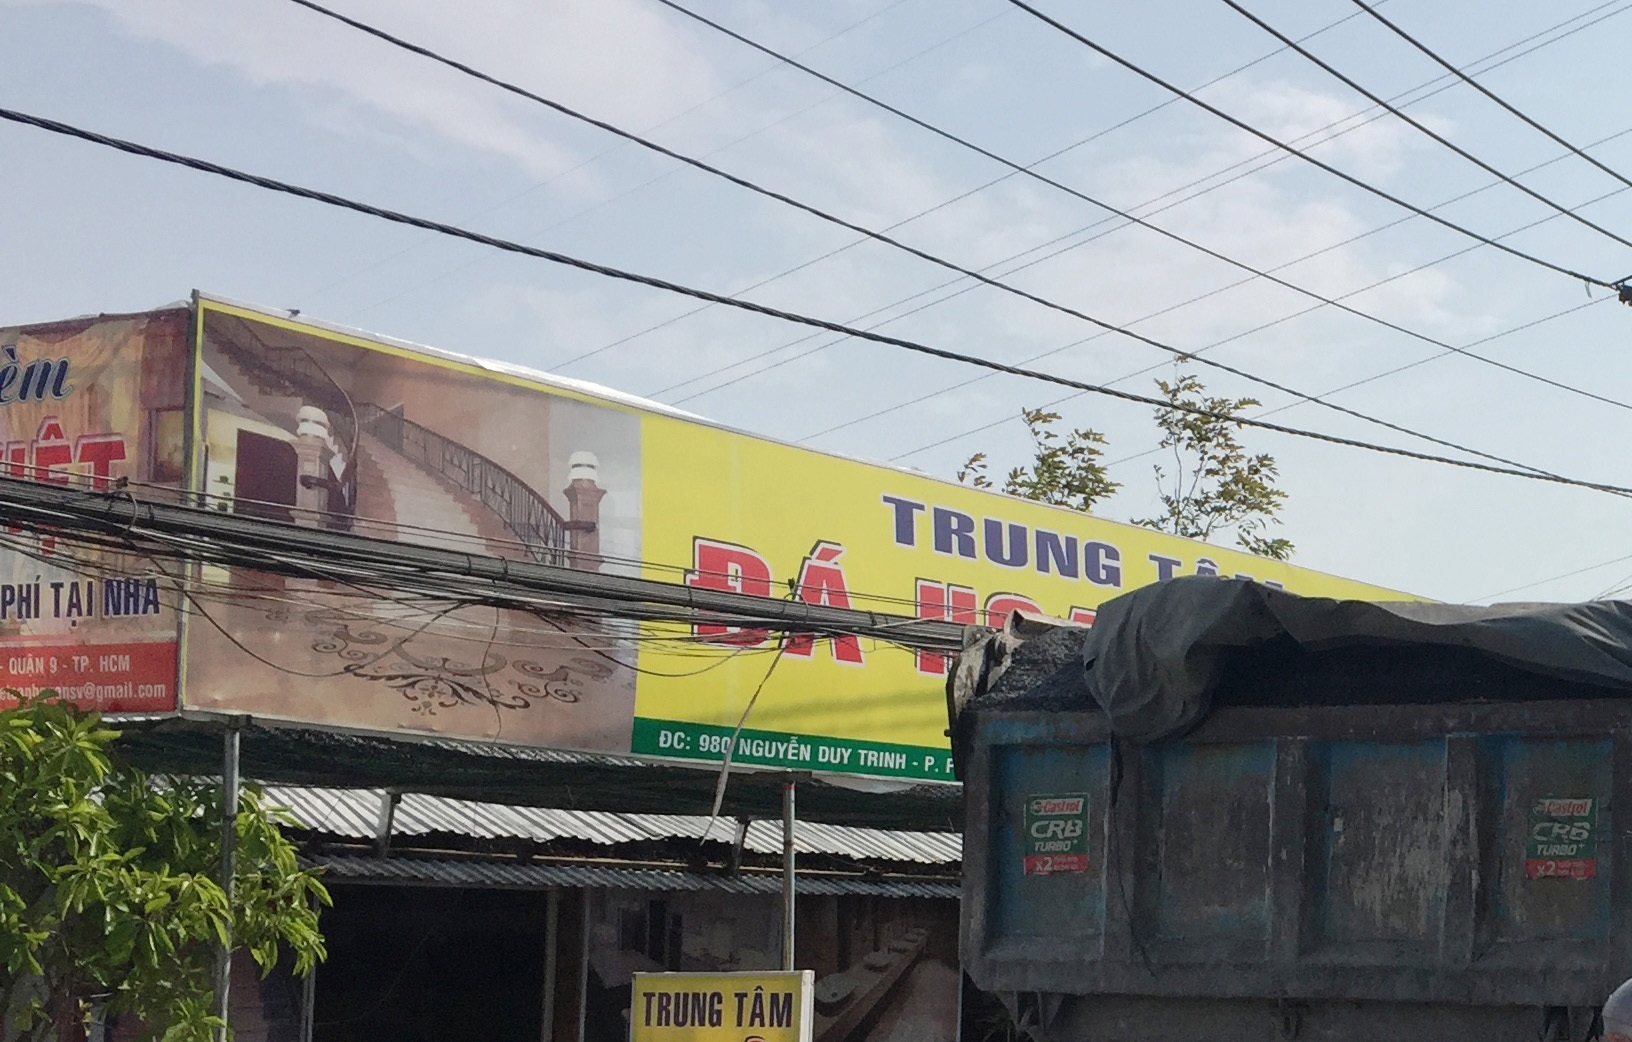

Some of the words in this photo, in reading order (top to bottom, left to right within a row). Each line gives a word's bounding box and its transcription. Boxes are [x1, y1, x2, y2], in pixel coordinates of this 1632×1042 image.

[882, 494, 1123, 589] TRUNG
[0, 575, 41, 620] PHÍ
[50, 580, 94, 628] TẠI
[684, 537, 864, 666] ĐÁ
[9, 653, 44, 678] QUẬN
[50, 656, 58, 674] 9
[72, 654, 94, 673] TP.
[100, 654, 131, 673] HCM
[658, 730, 691, 751] ĐC:
[698, 733, 731, 755] 980
[738, 736, 812, 763] NGUYỄN
[818, 744, 853, 765] DUY
[858, 749, 907, 770] TRINH
[924, 755, 939, 774] P.
[1043, 800, 1080, 814] Castrol
[642, 991, 722, 1028] TRUNG
[734, 985, 793, 1029] TÂM
